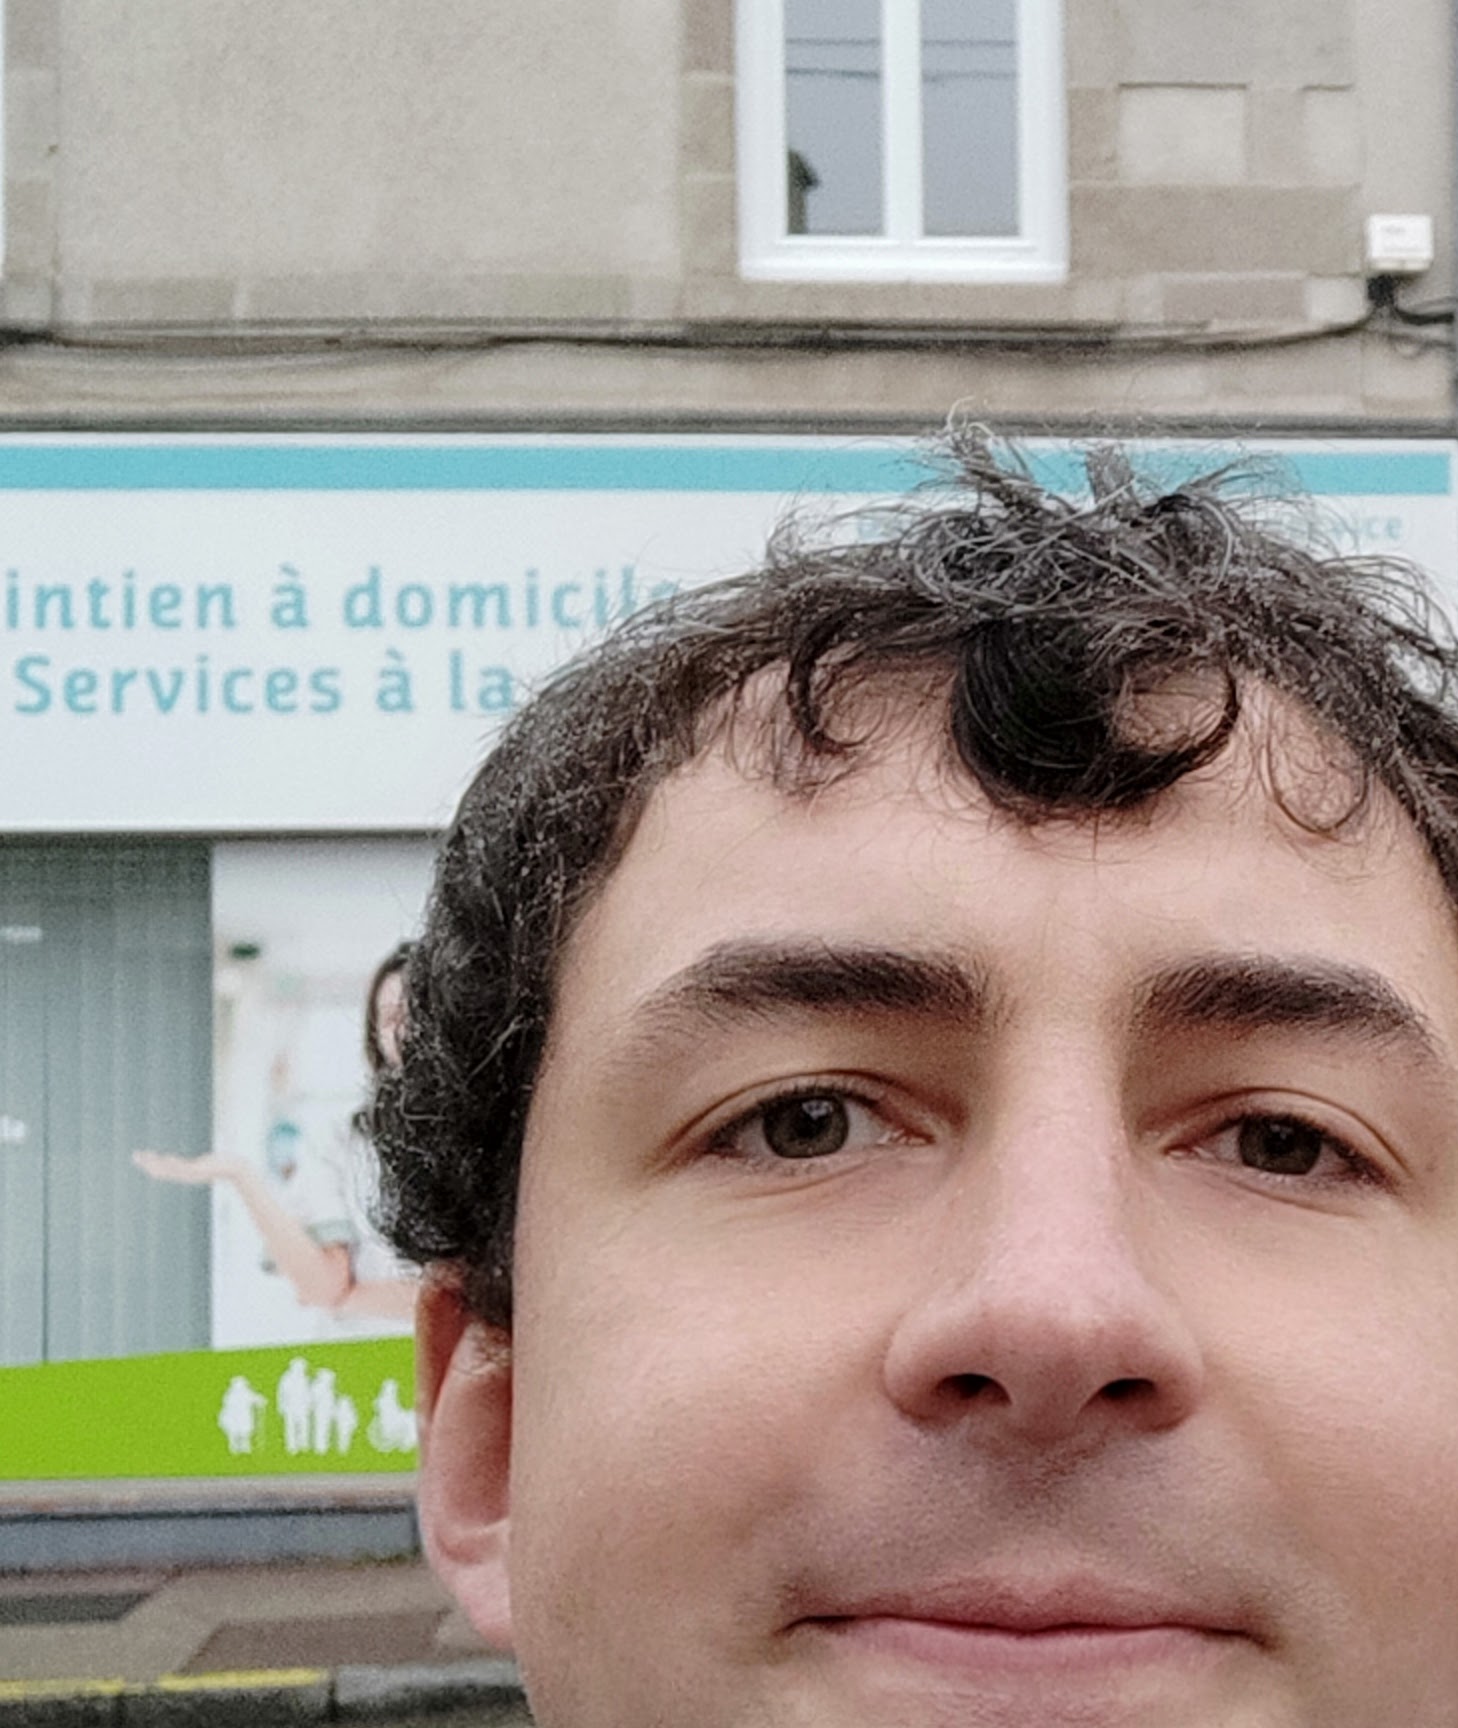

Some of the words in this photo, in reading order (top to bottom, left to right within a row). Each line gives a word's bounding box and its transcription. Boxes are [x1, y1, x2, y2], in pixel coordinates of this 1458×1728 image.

[271, 563, 309, 629] à
[14, 652, 342, 714] Services
[375, 649, 415, 714] à
[450, 649, 518, 714] la
